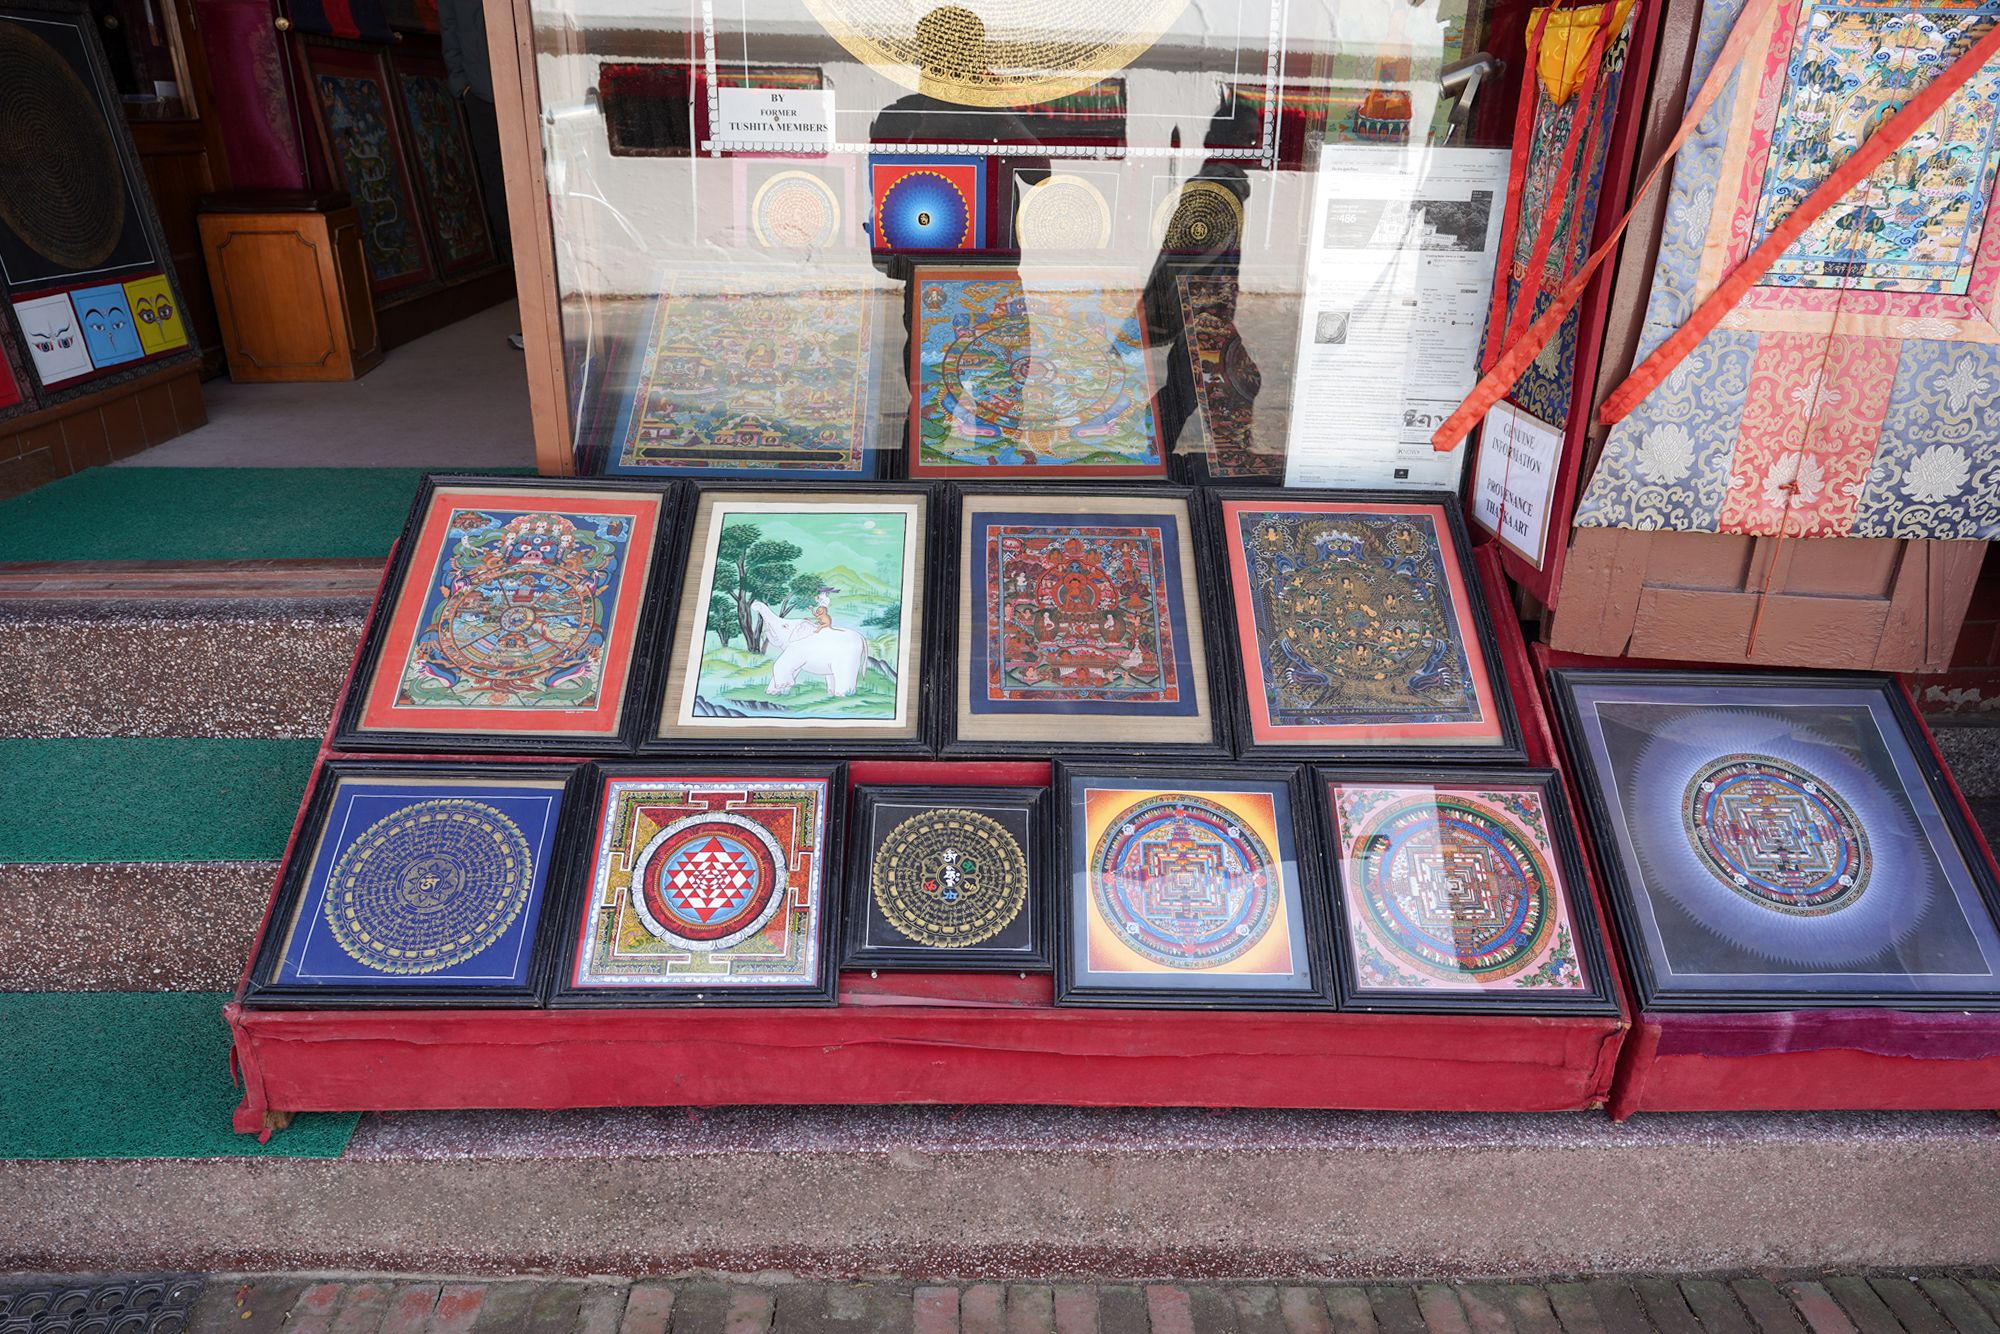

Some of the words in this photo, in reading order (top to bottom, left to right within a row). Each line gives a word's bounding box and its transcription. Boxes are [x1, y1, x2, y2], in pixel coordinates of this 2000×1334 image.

[771, 93, 785, 103] BY
[760, 108, 797, 117] FORMER
[729, 121, 775, 132] TUSHITA
[776, 123, 829, 132] MEMBERS
[1513, 519, 1529, 536] ART
